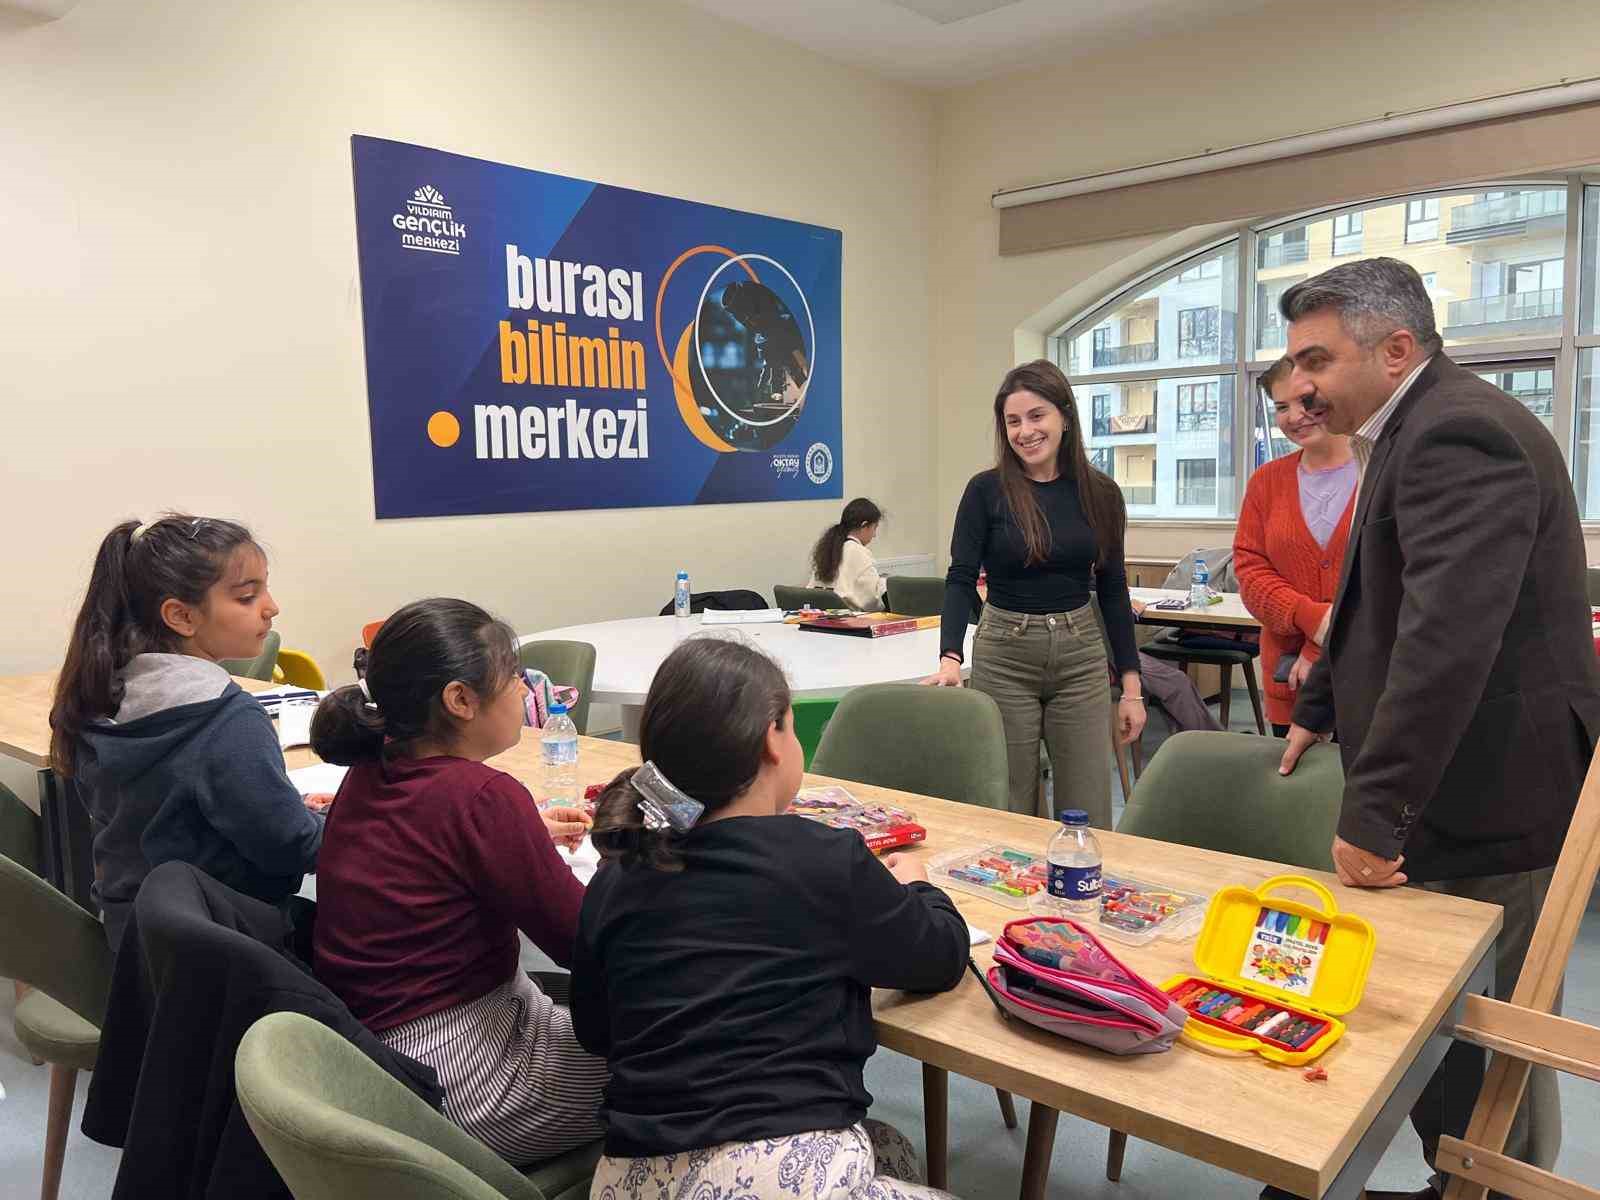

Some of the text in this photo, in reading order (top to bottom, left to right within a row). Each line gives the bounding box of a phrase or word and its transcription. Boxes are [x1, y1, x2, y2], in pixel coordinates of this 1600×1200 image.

[407, 205, 452, 219] YILDIRIM
[506, 244, 644, 321] burası
[499, 319, 646, 390] bilimin
[474, 398, 648, 459] merkezi
